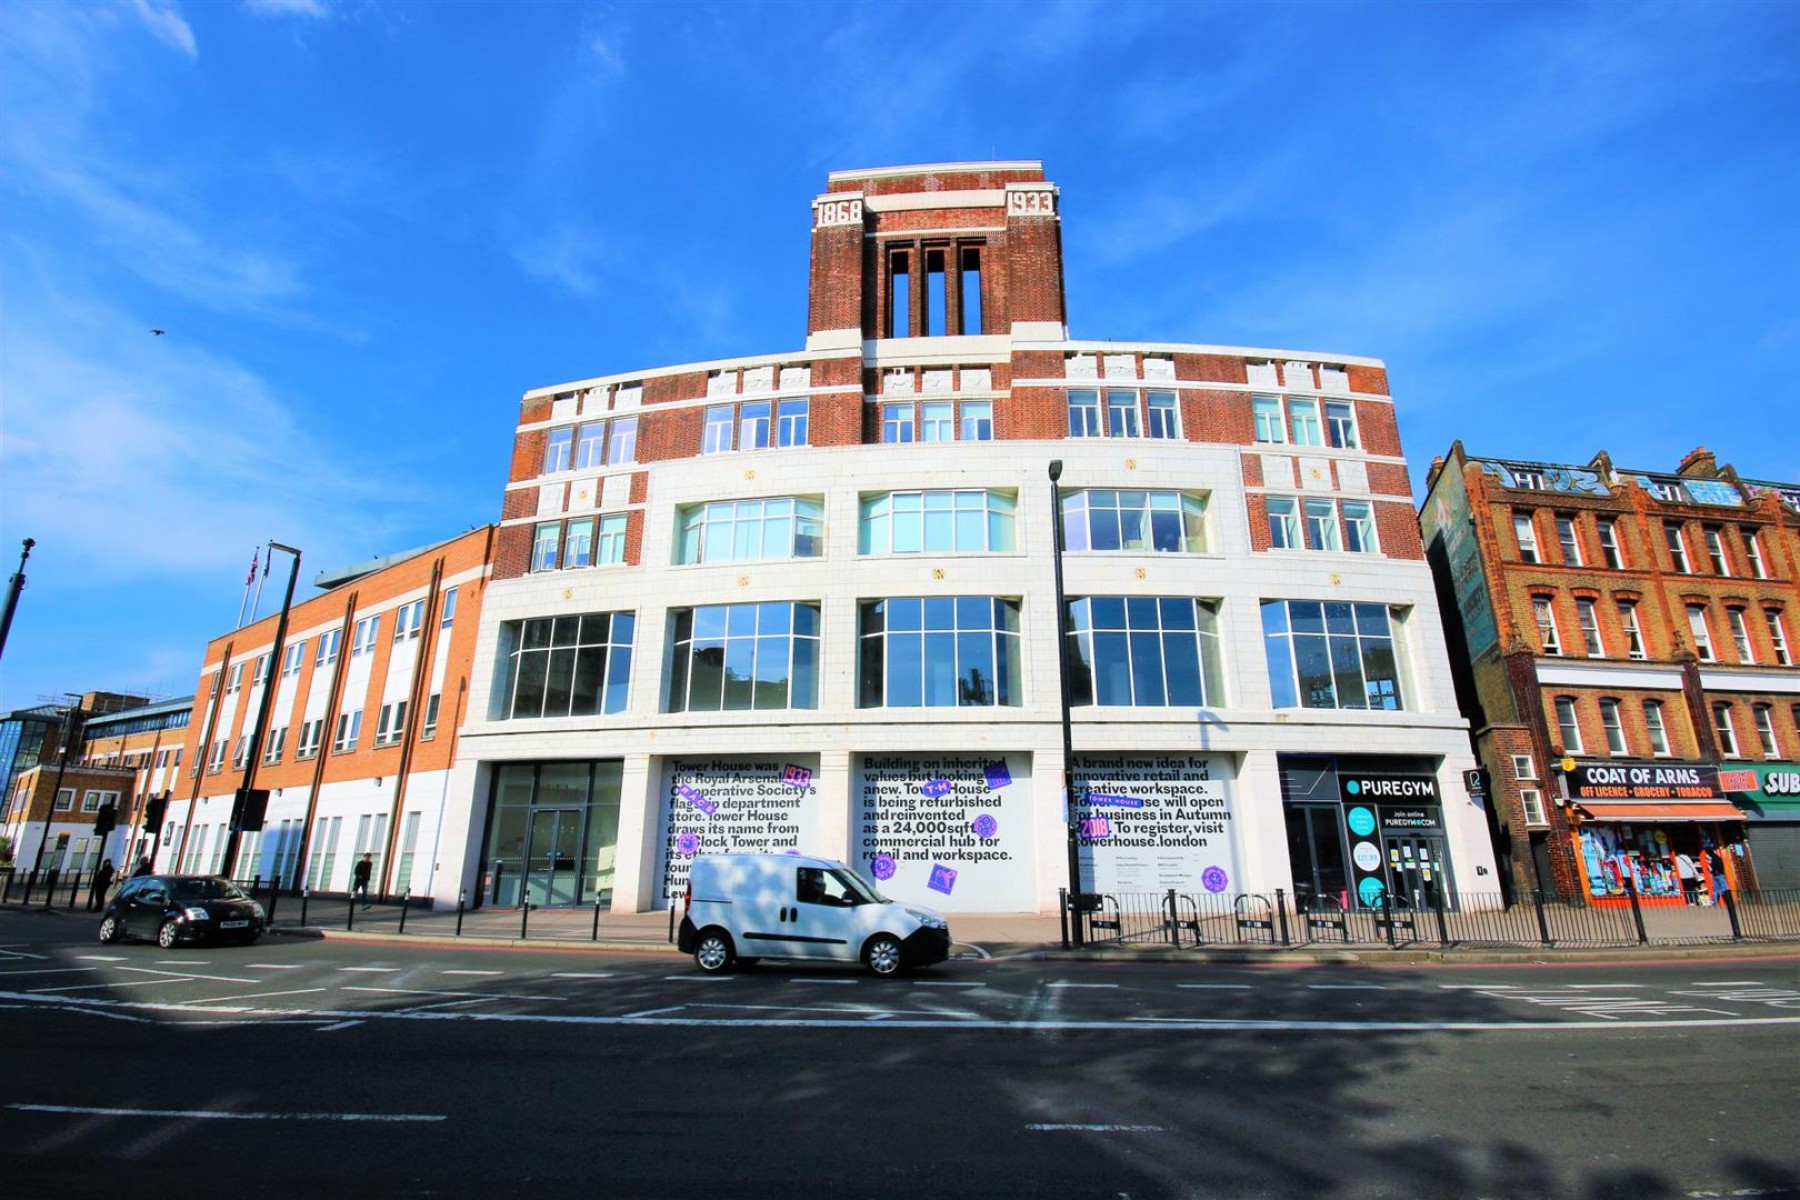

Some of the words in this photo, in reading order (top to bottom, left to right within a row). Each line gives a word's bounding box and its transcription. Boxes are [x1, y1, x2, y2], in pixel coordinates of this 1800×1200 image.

[1008, 191, 1053, 213] 1933
[818, 200, 862, 223] 1868
[673, 761, 709, 771] Tower
[712, 761, 752, 771] House
[754, 762, 779, 771] was
[864, 757, 920, 772] Building
[923, 761, 940, 769] on
[1083, 757, 1123, 769] brand
[1127, 760, 1154, 768] new
[1157, 757, 1185, 769] idea
[1188, 757, 1208, 768] for
[672, 773, 692, 784] the
[696, 773, 729, 787] Royal
[732, 772, 782, 784] Arsenal
[783, 766, 811, 788] 1933
[864, 770, 905, 781] values
[909, 770, 932, 781] but
[935, 770, 985, 785] looking
[1144, 770, 1180, 781] retail
[1184, 770, 1209, 781] and
[1587, 768, 1627, 784] COAT
[1630, 769, 1651, 784] OF
[1656, 769, 1700, 784] ARMS
[864, 786, 902, 794] anew.
[1130, 783, 1208, 797] workspace.
[1361, 780, 1434, 796] PUREGYM
[1580, 786, 1595, 796] OFF
[1596, 787, 1628, 797] LICENCE
[1633, 787, 1670, 797] GROCERY
[1676, 787, 1713, 797] TOBACCO
[722, 797, 800, 811] department
[864, 796, 875, 807] is
[879, 796, 916, 811] being
[920, 795, 1002, 807] refurbished
[1164, 796, 1188, 807] will
[1190, 799, 1224, 810] open
[669, 812, 705, 821] store.
[748, 810, 788, 821] House
[864, 809, 889, 820] and
[891, 809, 965, 820] reinvented
[1096, 809, 1156, 820] business
[1160, 809, 1172, 820] in
[1176, 808, 1231, 820] Autumn
[668, 823, 705, 834] draws
[709, 823, 725, 834] its
[728, 825, 764, 834] name
[767, 822, 799, 833] from
[863, 825, 879, 833] as
[882, 825, 890, 833] a
[1081, 818, 1108, 837] 2018
[1115, 822, 1131, 833] To
[1134, 822, 1192, 837] register,
[1194, 822, 1224, 833] visit
[731, 836, 769, 847] Tower
[772, 835, 798, 847] and
[863, 835, 945, 847] commercial
[950, 835, 976, 847] hub
[979, 837, 1000, 847] for
[666, 848, 682, 860] its
[903, 849, 928, 860] and
[932, 849, 1013, 864] workspace.
